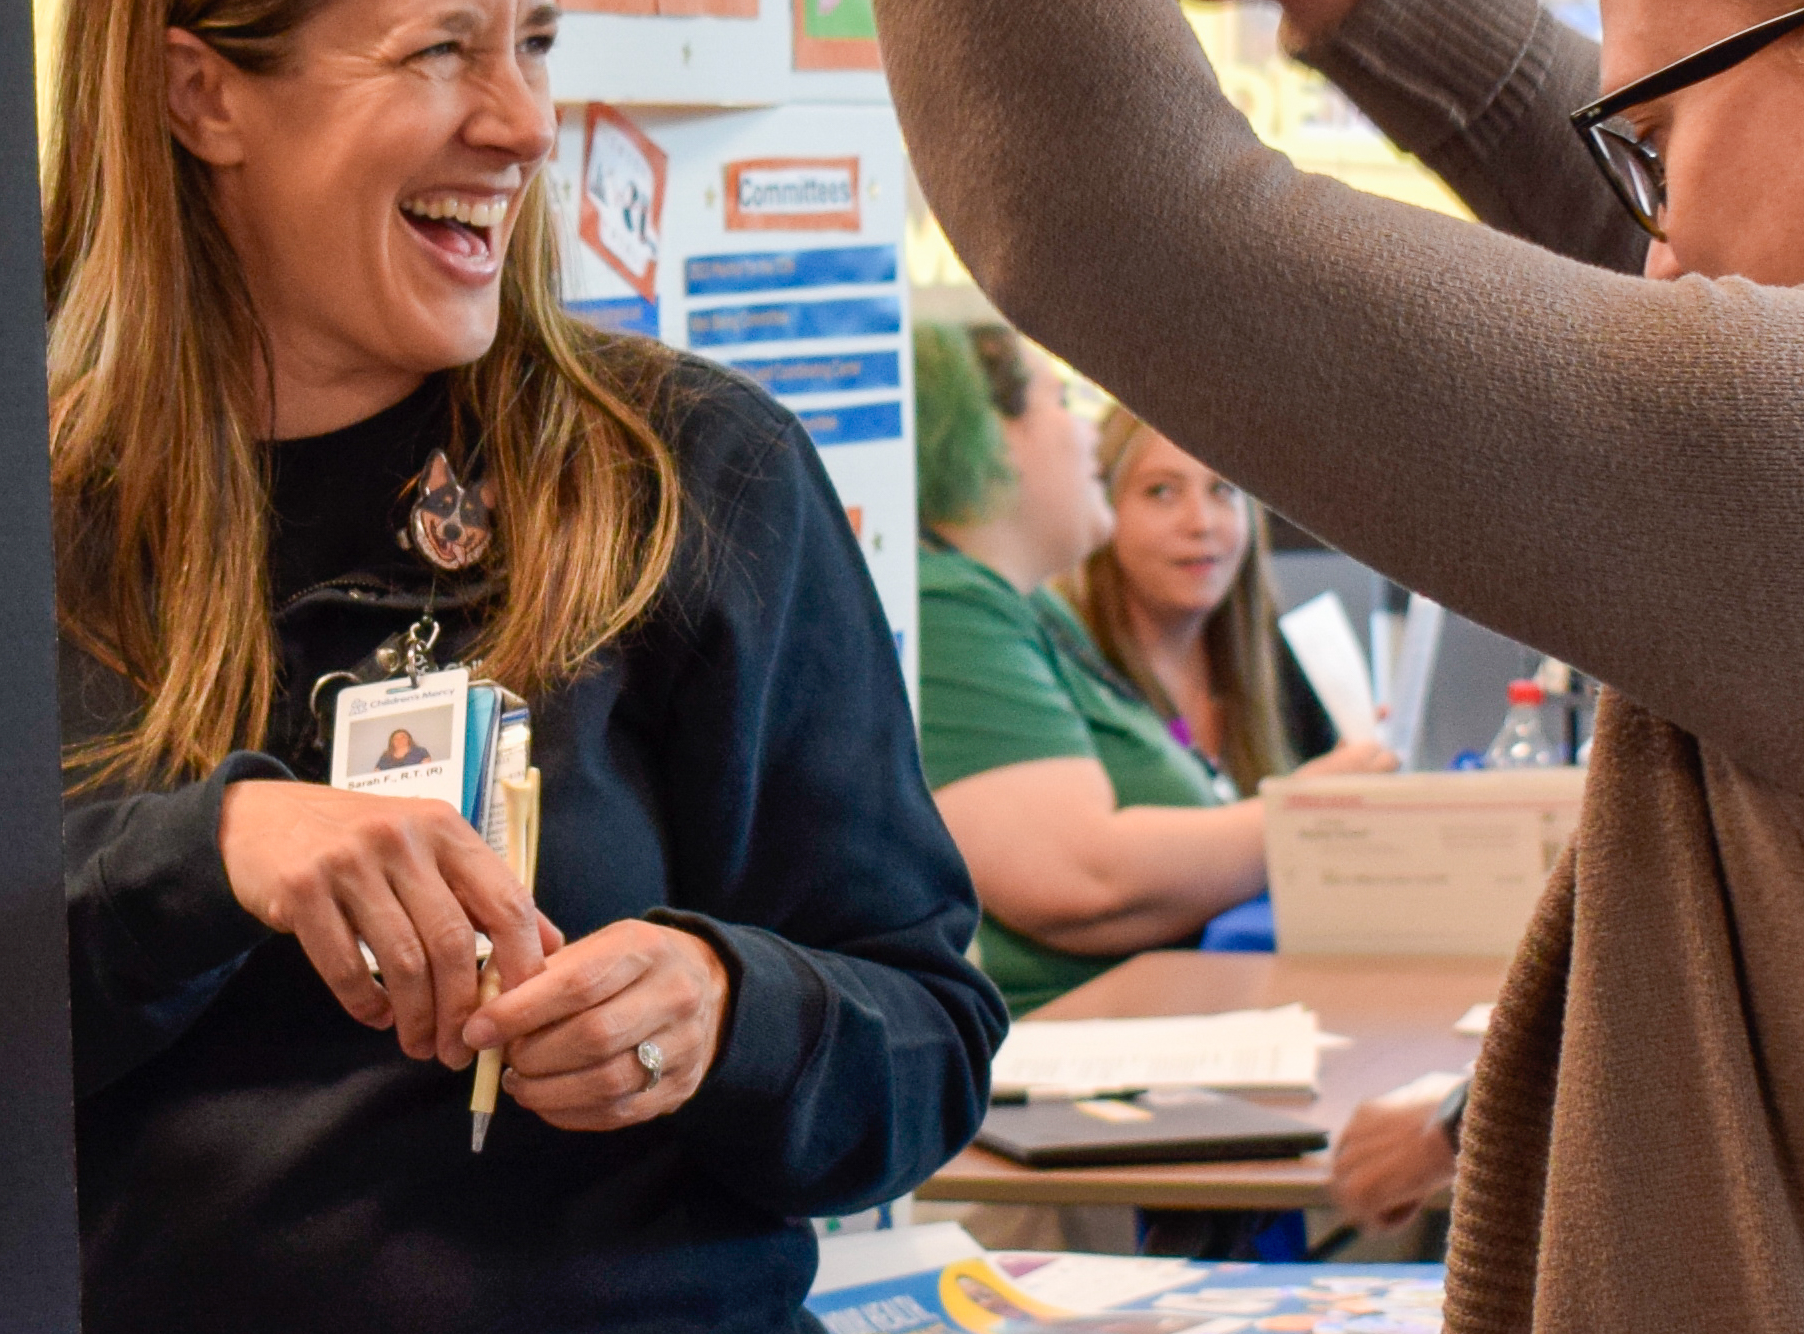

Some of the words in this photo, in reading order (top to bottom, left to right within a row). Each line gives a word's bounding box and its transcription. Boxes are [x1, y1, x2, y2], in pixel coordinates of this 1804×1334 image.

[739, 175, 851, 207] Committees
[370, 695, 421, 708] Children's
[422, 689, 455, 698] Mercy
[348, 777, 380, 789] Sarah
[426, 766, 443, 777] (R)
